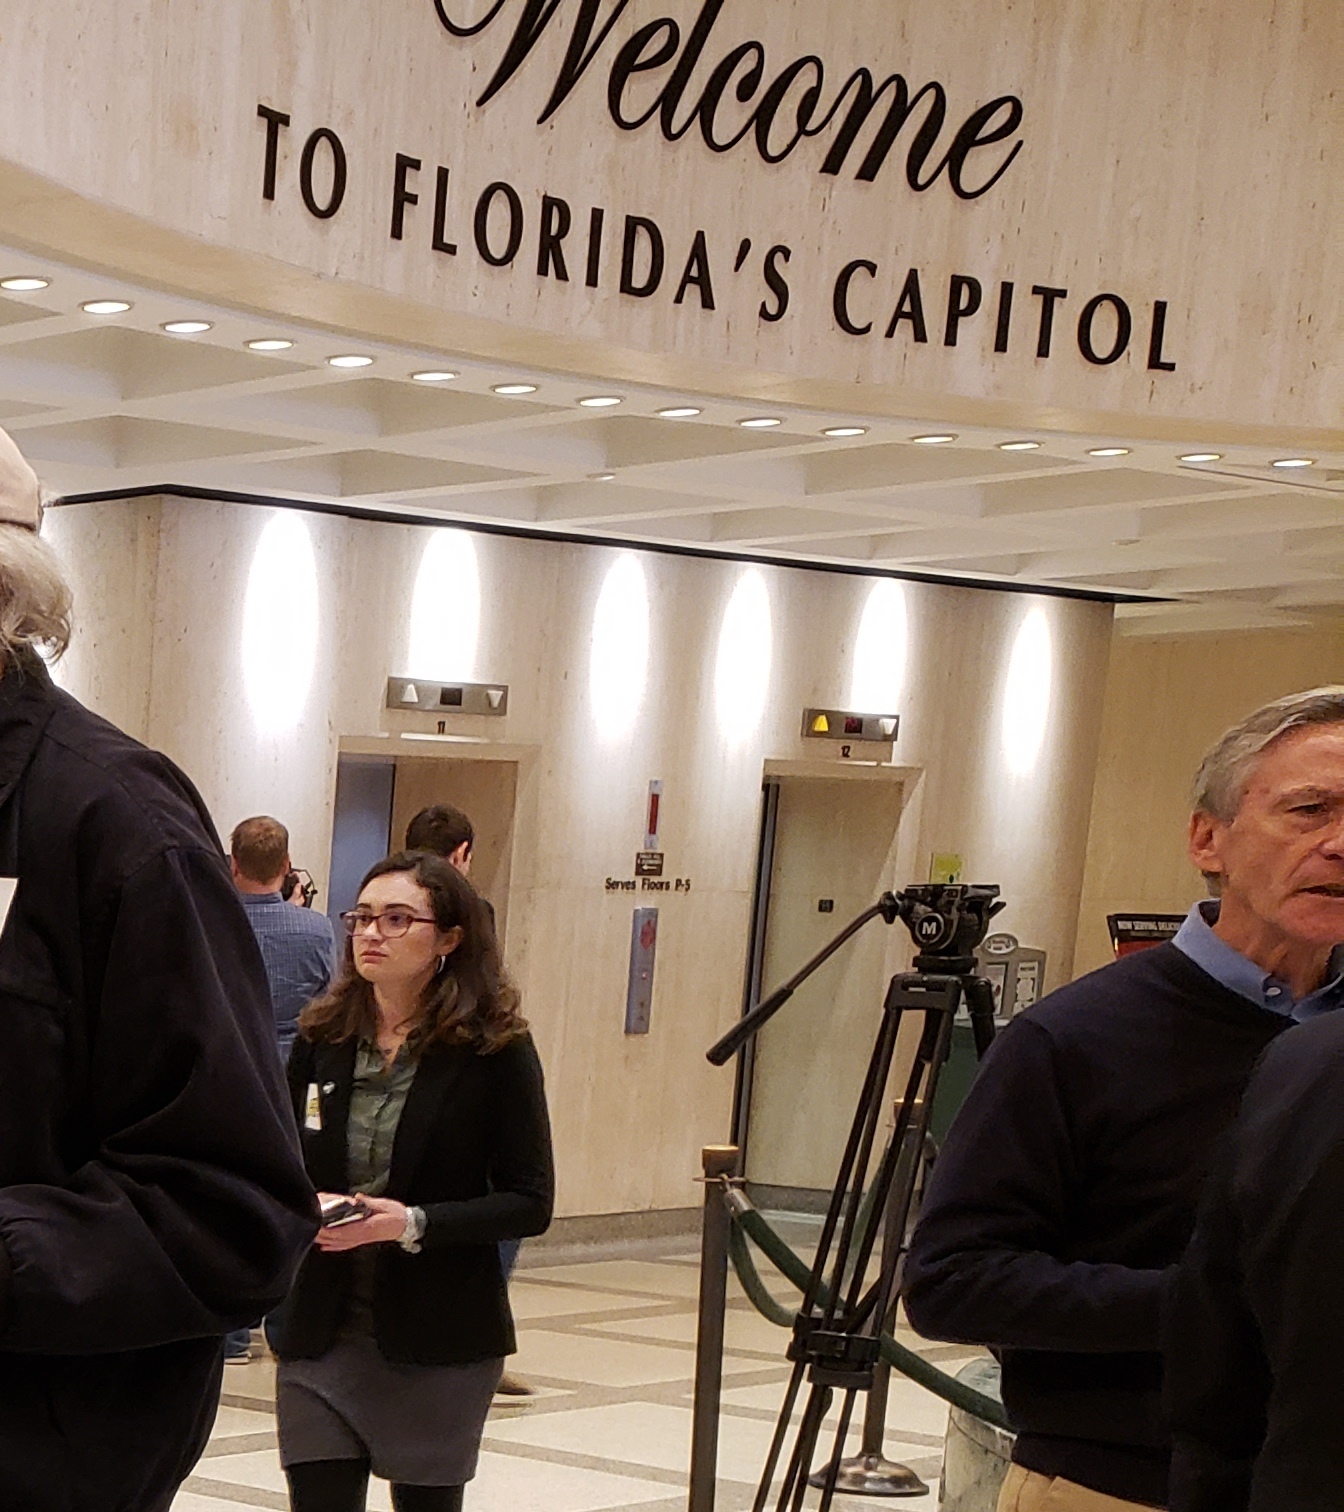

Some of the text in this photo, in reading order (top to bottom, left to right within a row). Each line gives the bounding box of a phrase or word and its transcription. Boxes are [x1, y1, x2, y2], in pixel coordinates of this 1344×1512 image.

[433, 0, 1023, 199] Welcome
[257, 104, 1178, 372] TO FLORIDA'S CAPITOL
[604, 877, 637, 891] Serves
[641, 877, 670, 891] Floors
[921, 921, 937, 935] M
